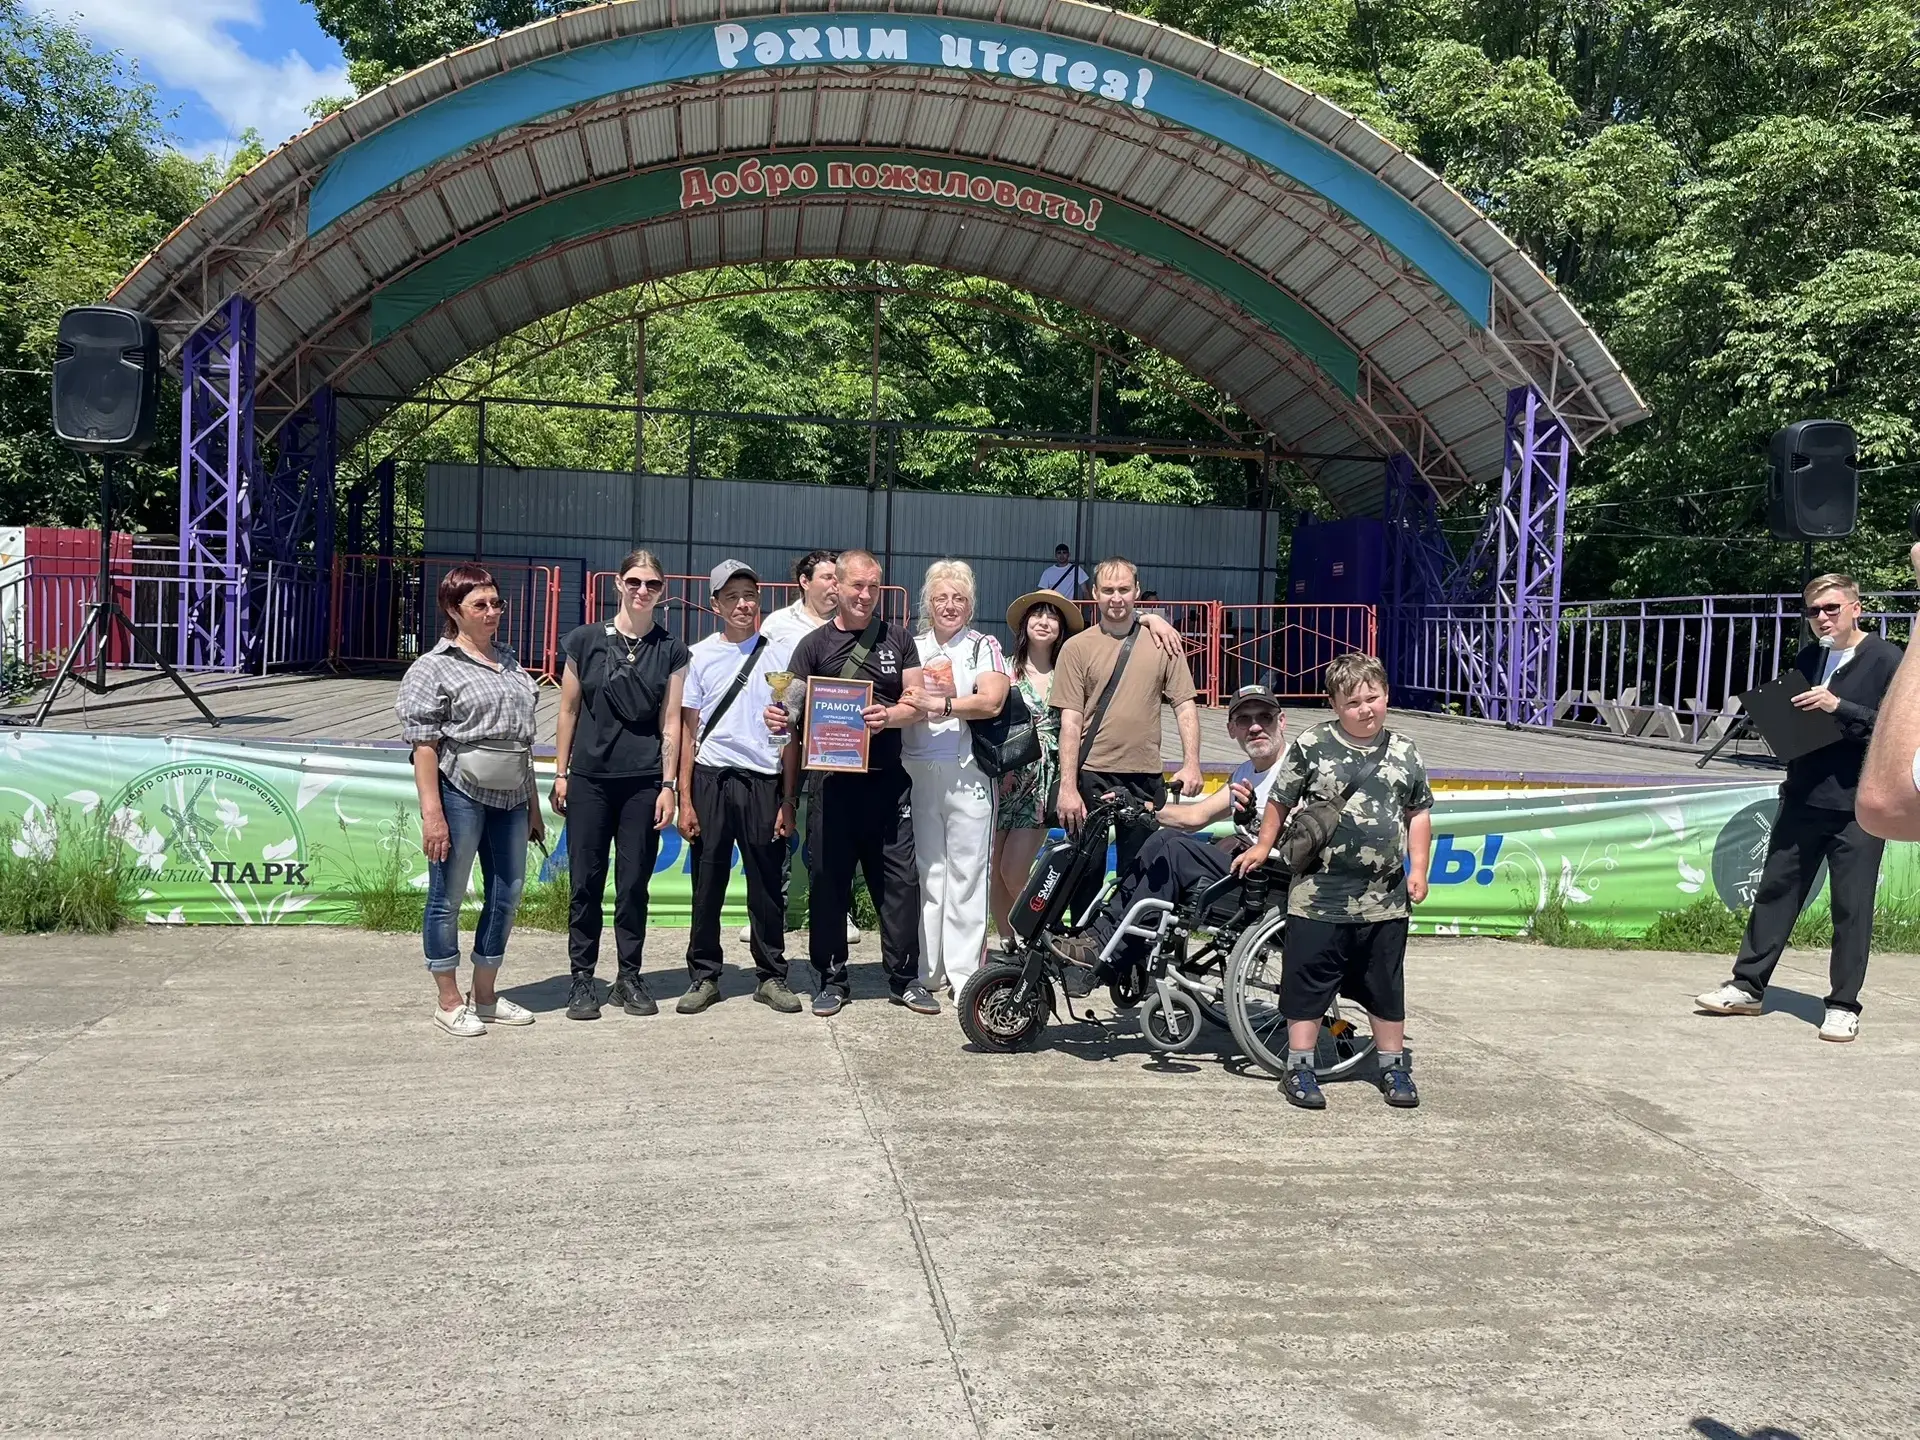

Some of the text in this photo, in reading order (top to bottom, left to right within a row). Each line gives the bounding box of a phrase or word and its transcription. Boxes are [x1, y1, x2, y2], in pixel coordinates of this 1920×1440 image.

[714, 24, 1153, 109] Рәхим итегез!
[679, 158, 1103, 232] Добро пожаловать!
[815, 701, 862, 712] ГРАМОТА
[122, 780, 154, 807] центр
[156, 767, 202, 783] отдыха
[216, 769, 284, 816] развлечений
[209, 861, 309, 885] ПАРК
